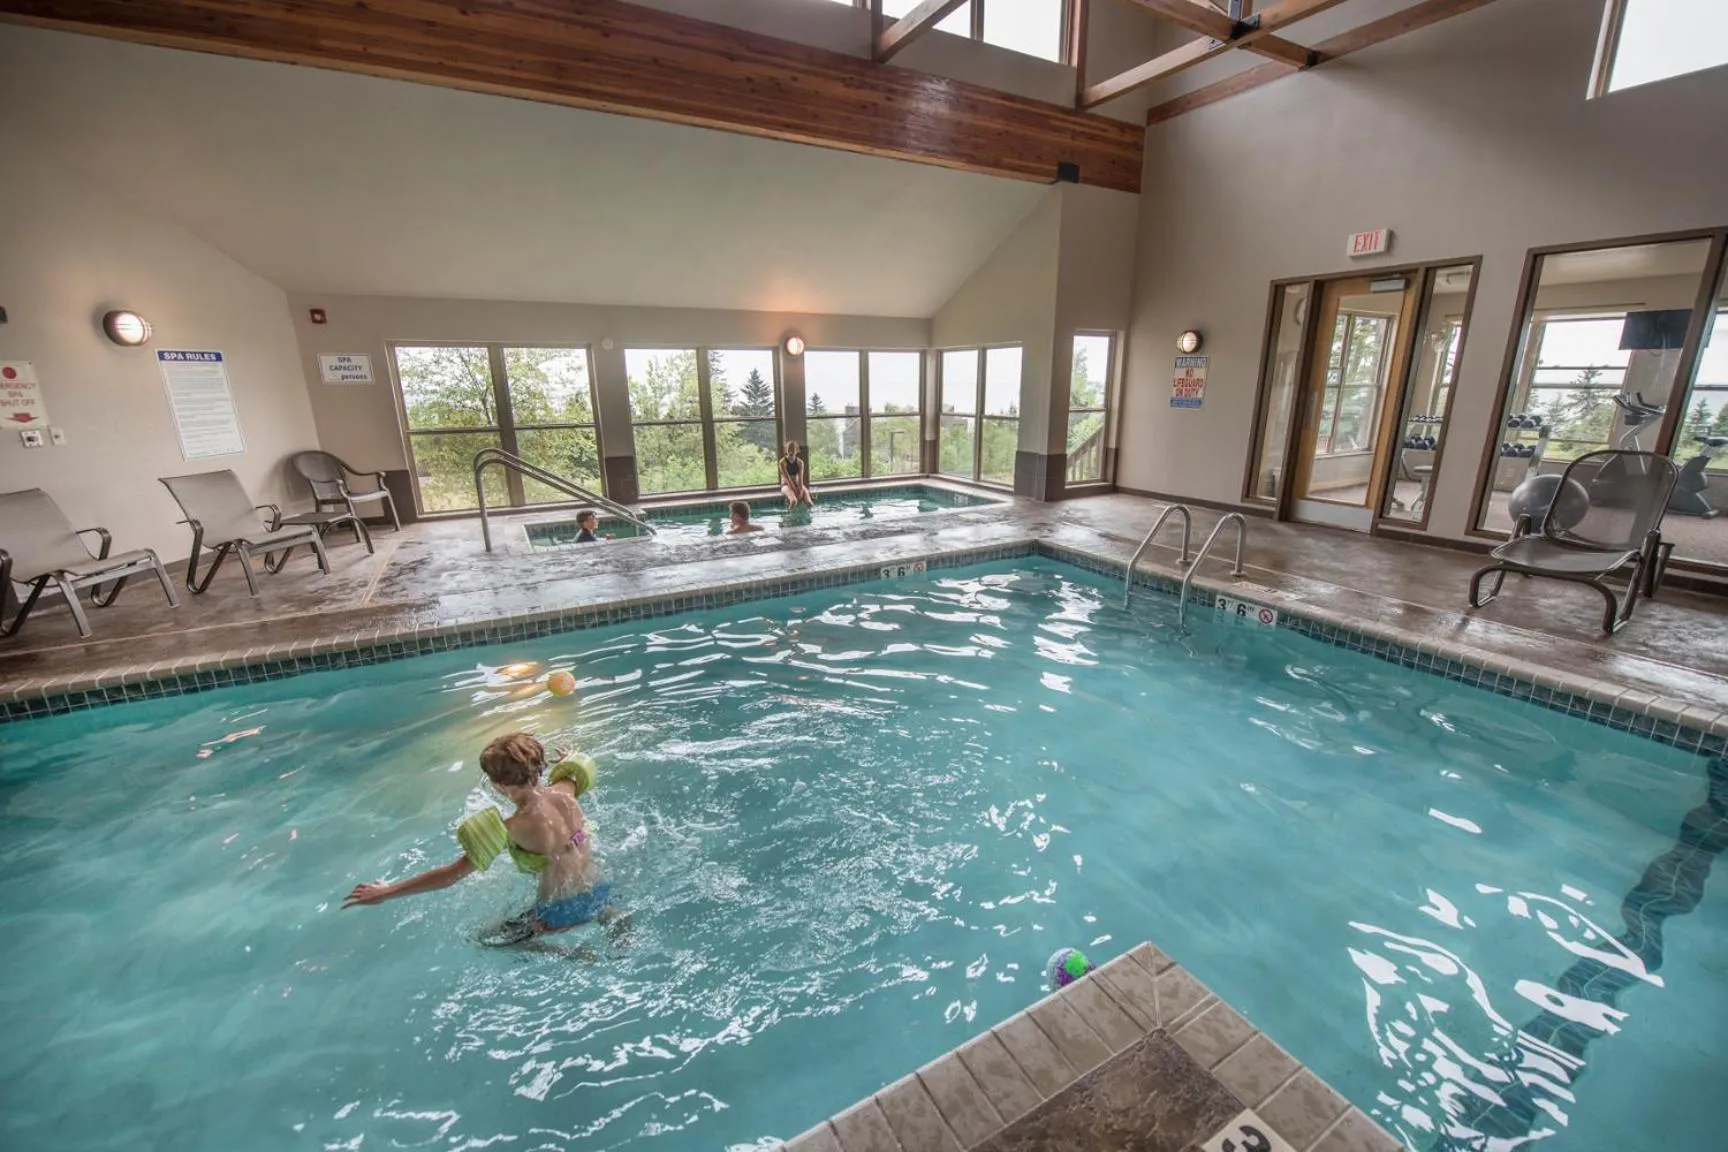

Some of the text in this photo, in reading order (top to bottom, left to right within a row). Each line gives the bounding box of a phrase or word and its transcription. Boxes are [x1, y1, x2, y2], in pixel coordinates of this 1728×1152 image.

[1353, 231, 1381, 254] EXIT
[163, 352, 217, 361] SPA RULES
[1217, 598, 1226, 611] 3
[1236, 603, 1247, 617] 6
